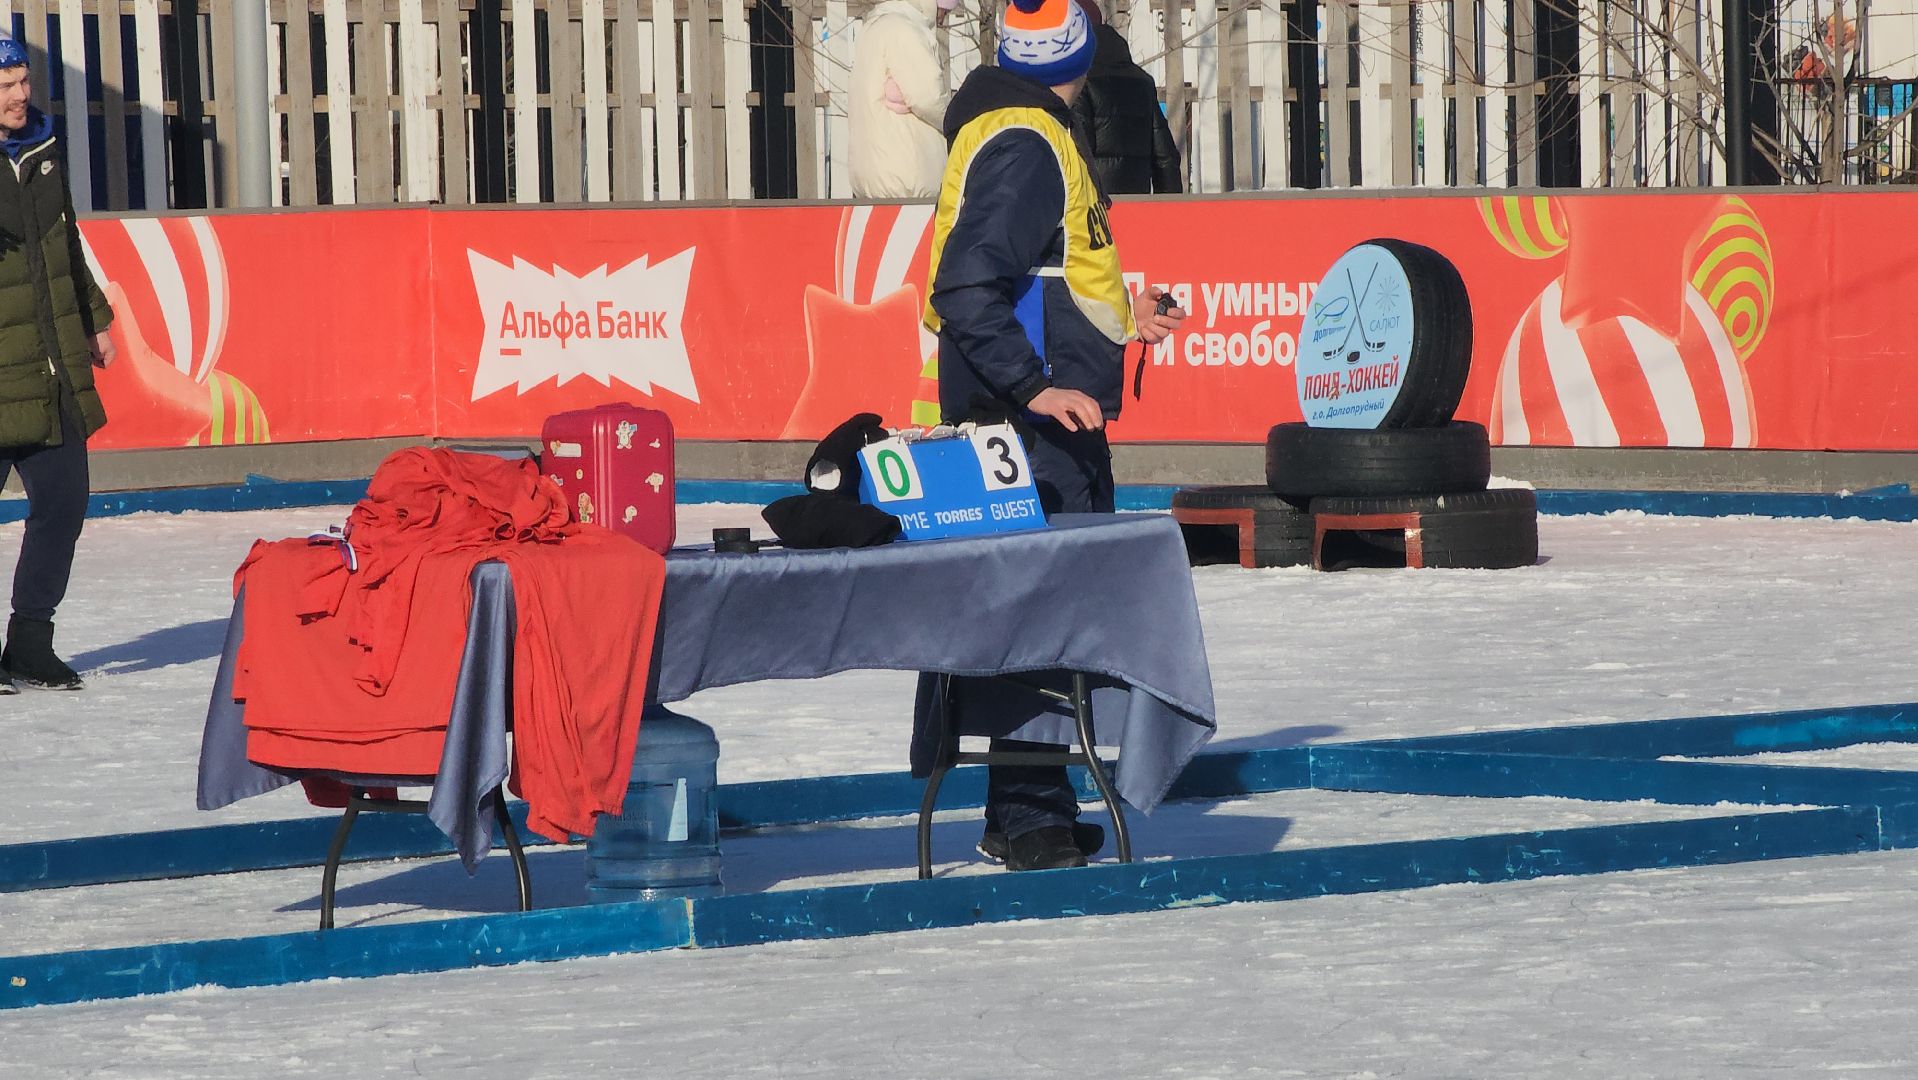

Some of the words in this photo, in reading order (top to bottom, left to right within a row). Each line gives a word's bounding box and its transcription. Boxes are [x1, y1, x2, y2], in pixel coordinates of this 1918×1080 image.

[500, 301, 591, 349] Альфа
[596, 301, 668, 339] Банк
[1153, 331, 1175, 366] и
[1185, 320, 1298, 373] свобо
[1304, 354, 1399, 400] ПОНД-ХОККЕЙ
[1326, 398, 1385, 420] Долгопрудный
[877, 449, 911, 497] 0
[987, 436, 1019, 485] 3
[934, 507, 983, 526] TORRES
[990, 499, 1036, 521] GUEST
